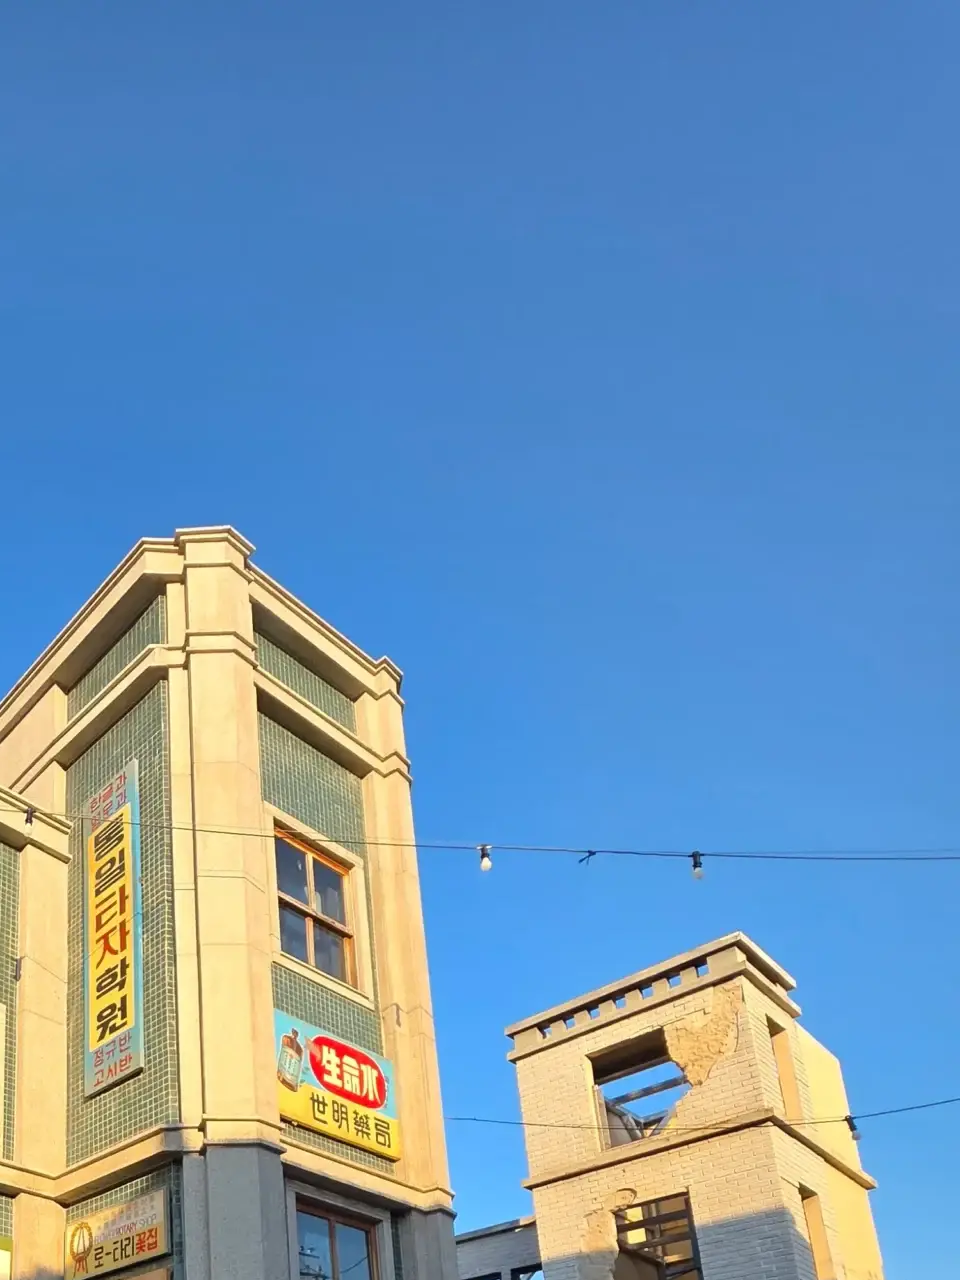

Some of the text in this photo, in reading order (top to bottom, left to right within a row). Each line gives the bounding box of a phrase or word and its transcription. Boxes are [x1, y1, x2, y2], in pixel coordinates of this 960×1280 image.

[94, 812, 130, 1043] 통일타자학원
[94, 1030, 132, 1067] 정규반
[94, 1052, 132, 1087] 고시반
[321, 1045, 381, 1105] 生命水
